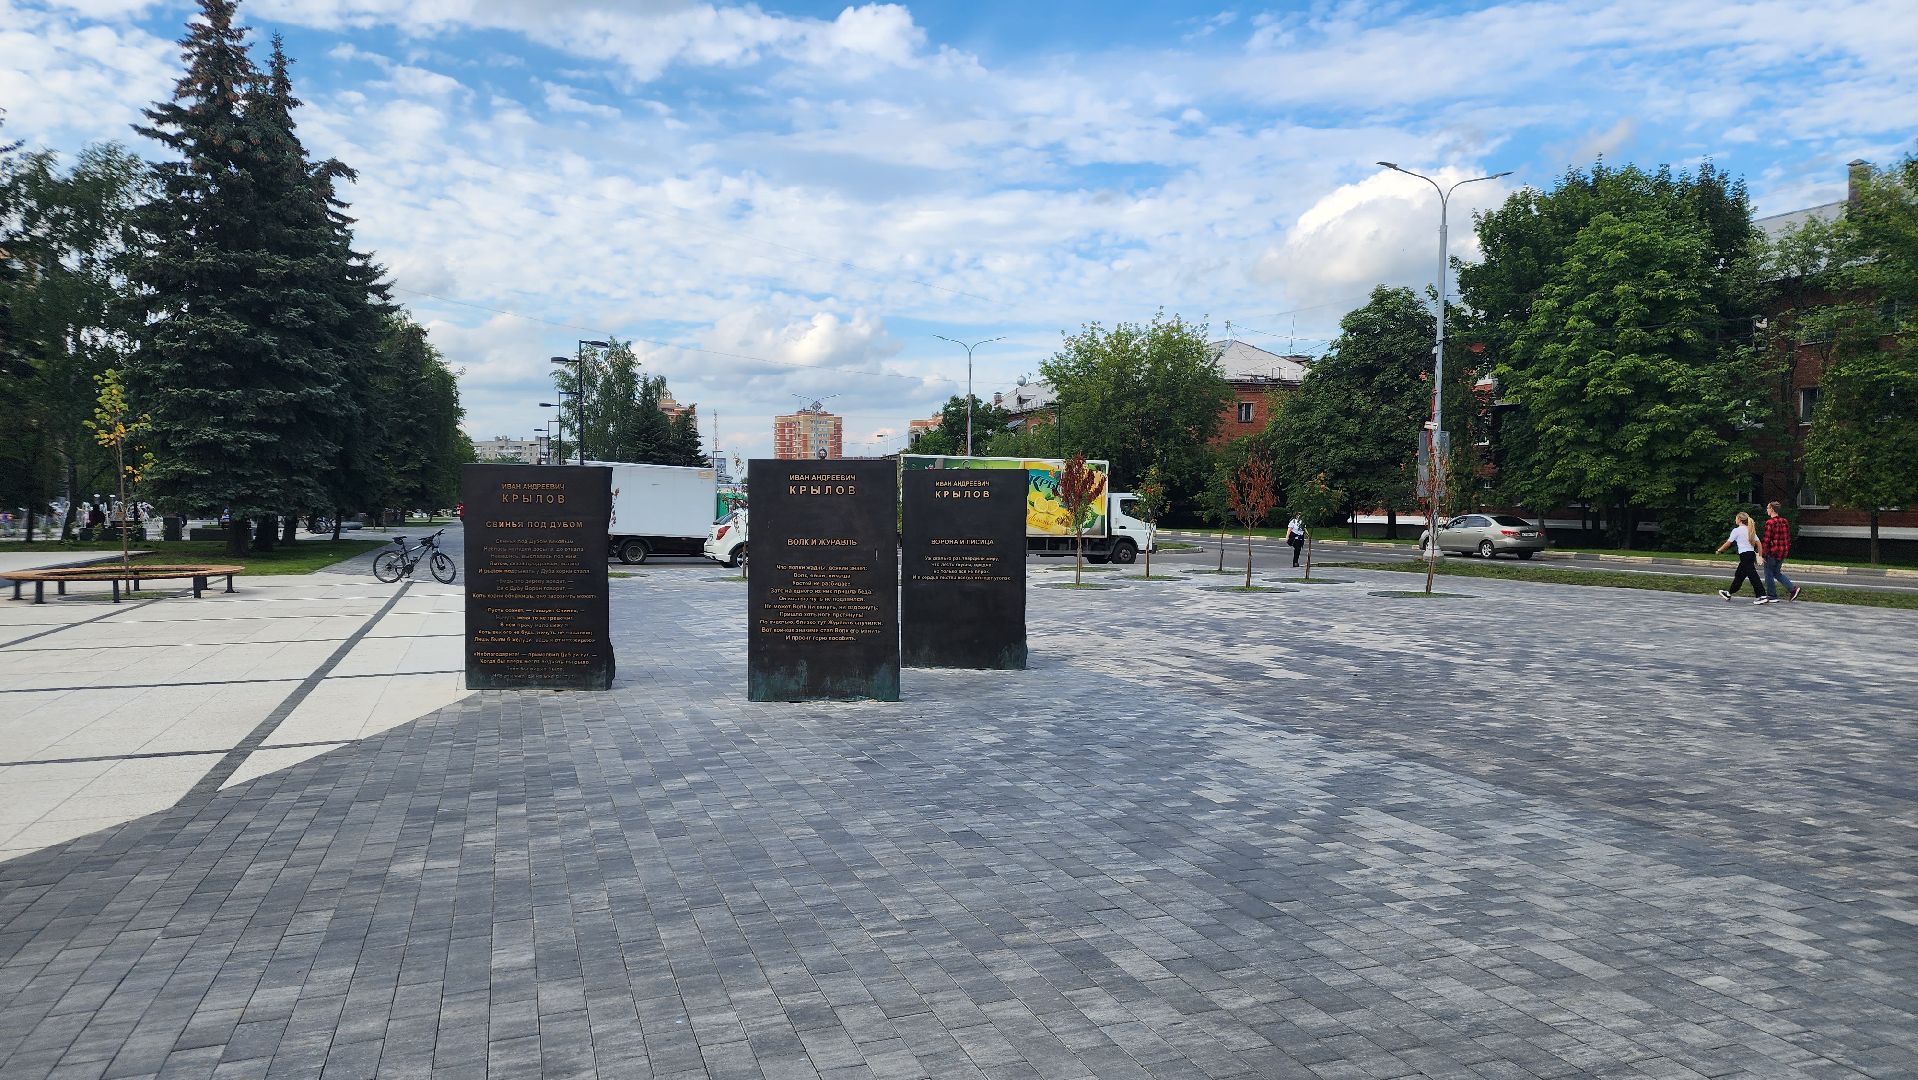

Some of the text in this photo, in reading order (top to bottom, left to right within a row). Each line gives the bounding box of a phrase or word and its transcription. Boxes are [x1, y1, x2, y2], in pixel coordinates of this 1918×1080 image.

[790, 486, 856, 495] КРЫЛОВ
[502, 494, 565, 503] КРЫЛОВ
[788, 538, 858, 546] ВОЛК И ЖУРАВЛЬ
